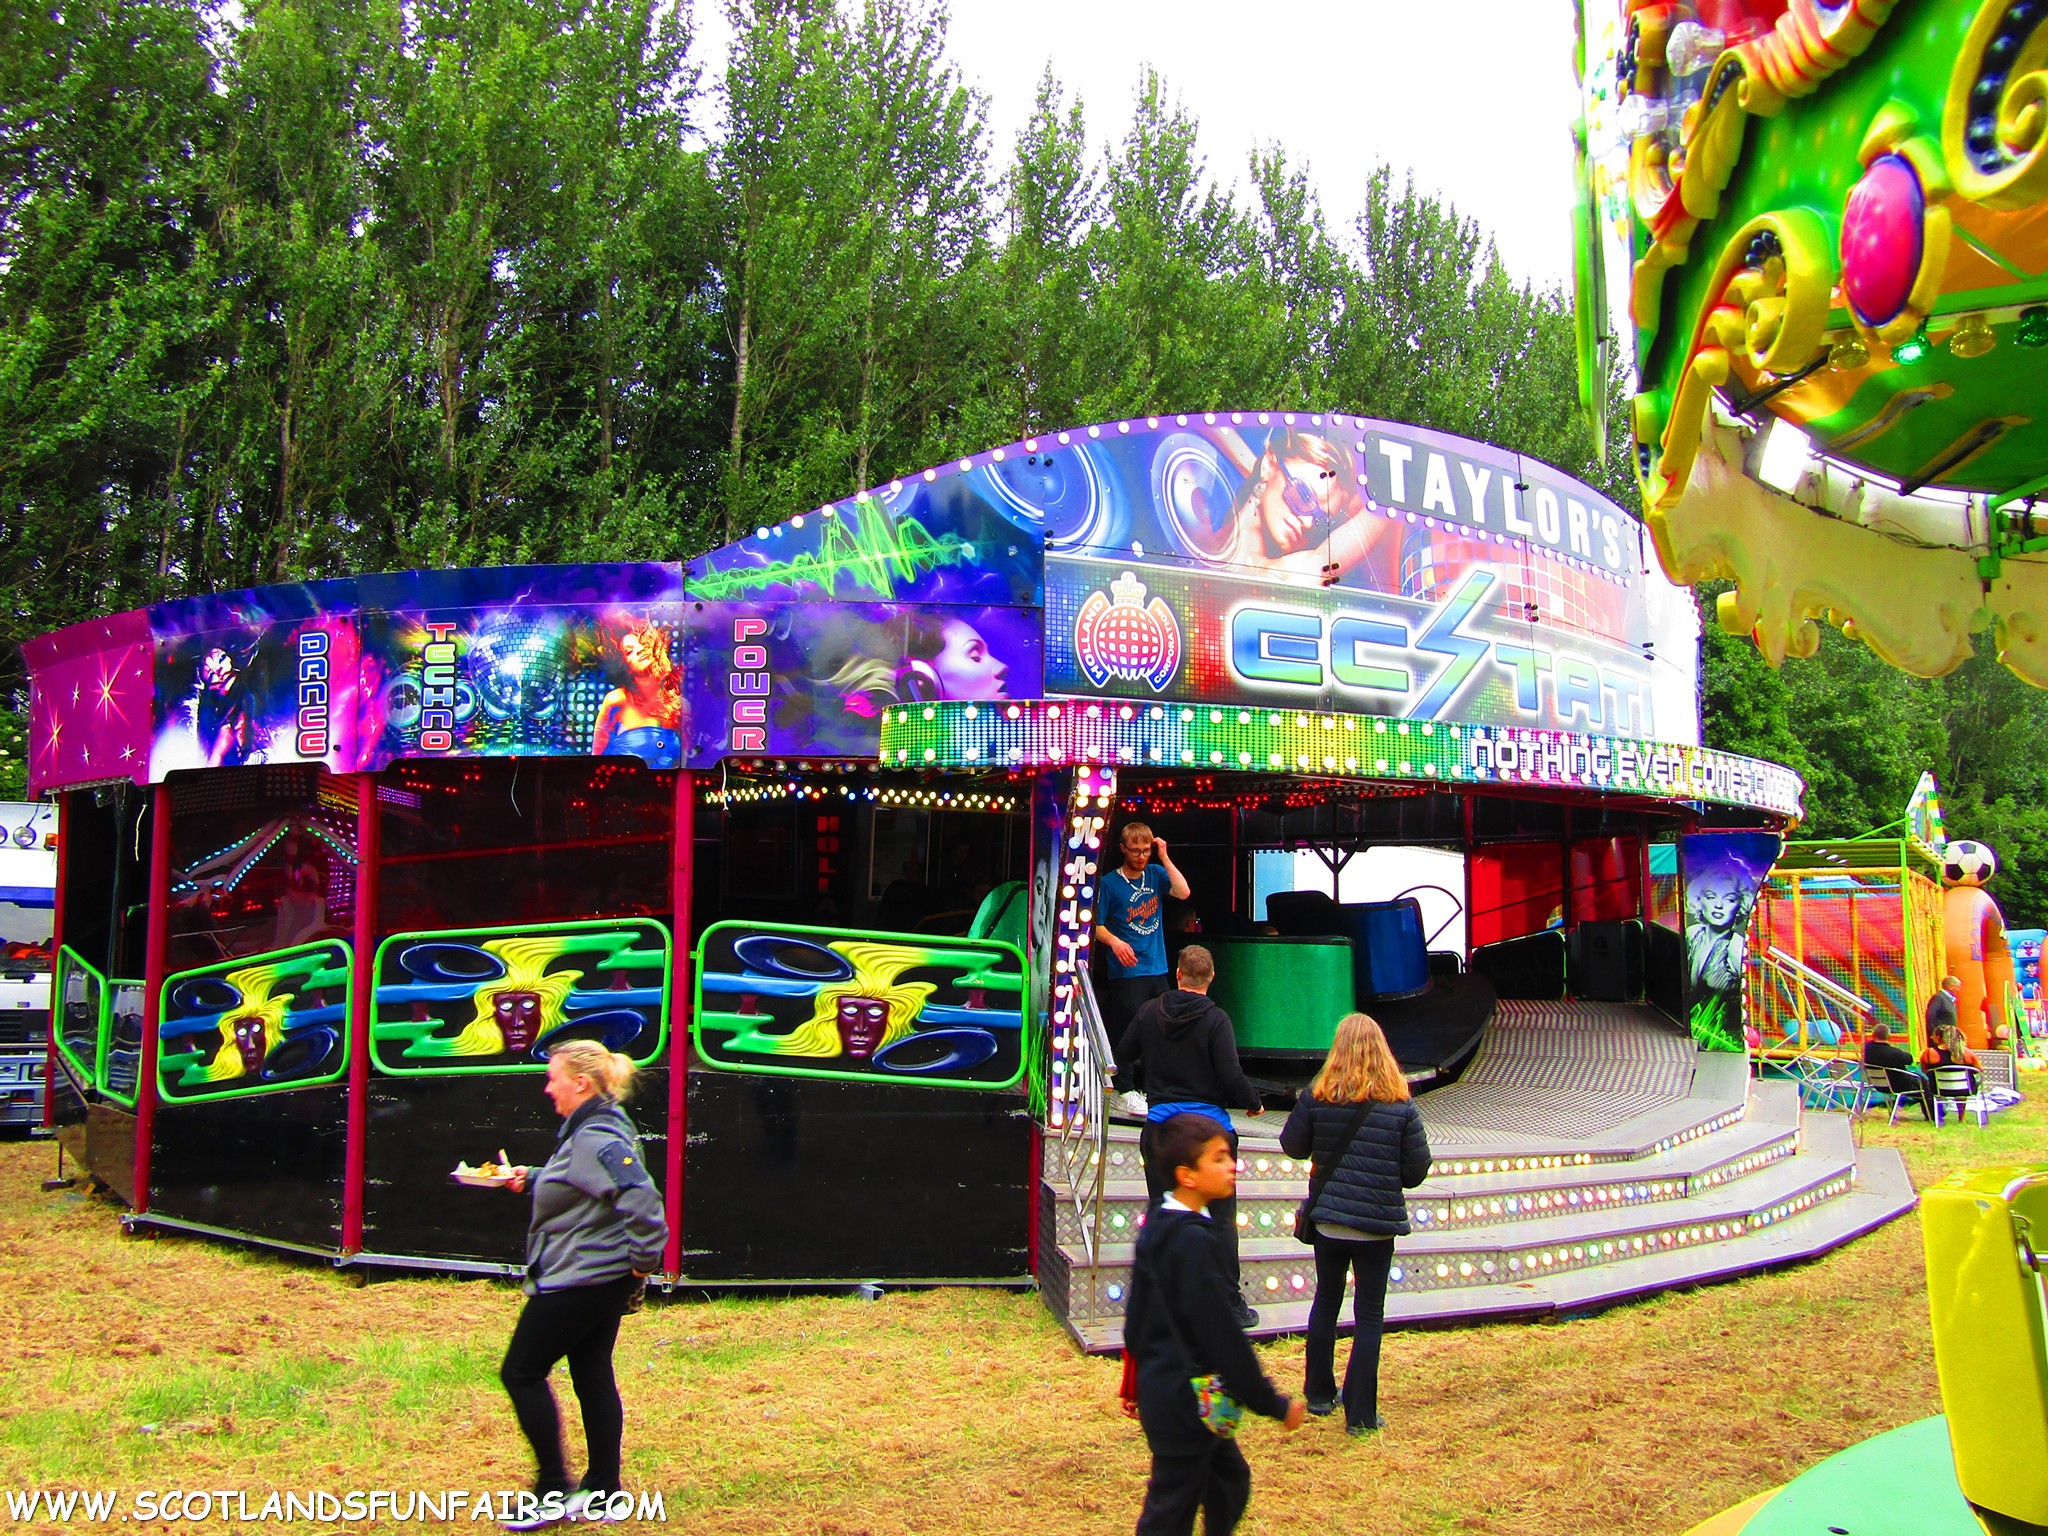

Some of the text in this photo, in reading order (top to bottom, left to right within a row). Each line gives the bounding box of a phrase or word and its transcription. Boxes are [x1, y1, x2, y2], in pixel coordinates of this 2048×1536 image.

[1379, 439, 1621, 569] TAYLOR'S
[299, 632, 328, 754] DANCE
[421, 623, 456, 750] TECHNO
[730, 619, 770, 750] POWER
[1081, 599, 1104, 680] HOLLAND
[1154, 606, 1175, 684] CORPORATION
[1471, 738, 1611, 777] NOTHING
[1618, 750, 1684, 782] EVEN
[1690, 759, 1751, 793] COMES
